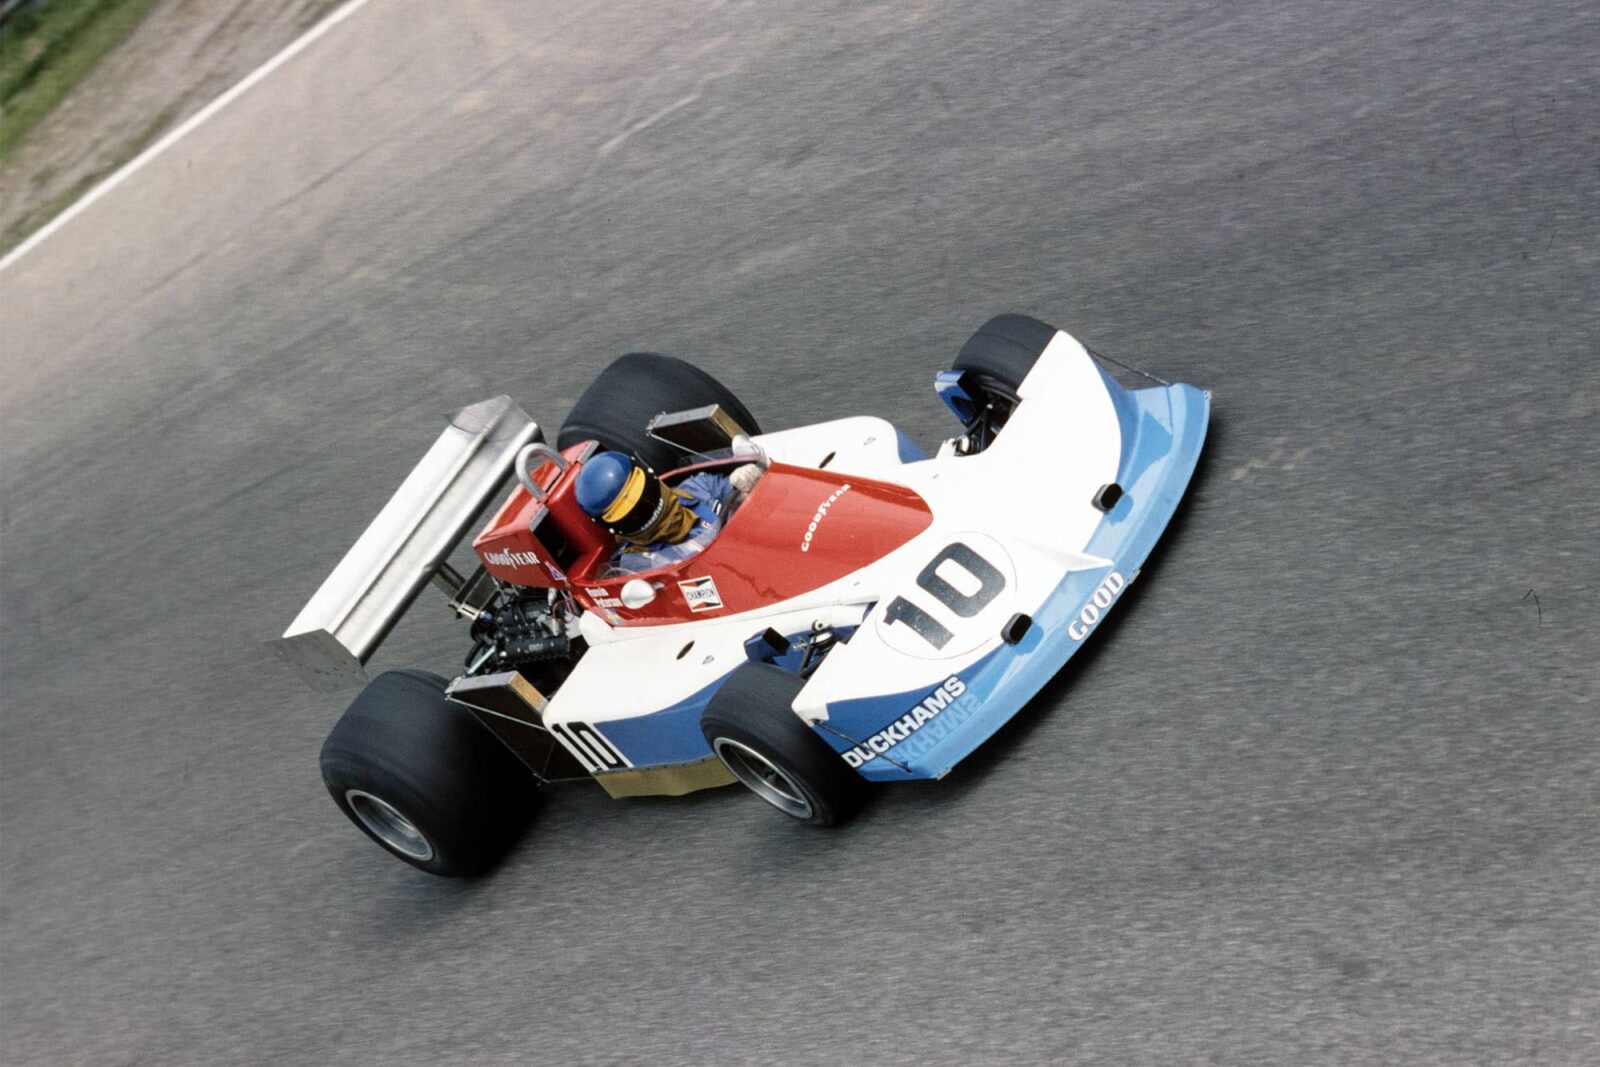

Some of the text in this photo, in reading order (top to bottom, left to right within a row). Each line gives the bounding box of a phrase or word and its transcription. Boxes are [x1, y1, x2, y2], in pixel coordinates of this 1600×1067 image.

[801, 484, 851, 552] GOODYEAR
[484, 547, 540, 570] GOODYEAR
[882, 541, 1006, 651] 10
[1068, 571, 1124, 640] GOOD
[552, 721, 629, 771] 10
[841, 676, 967, 768] DUCKHAMS
